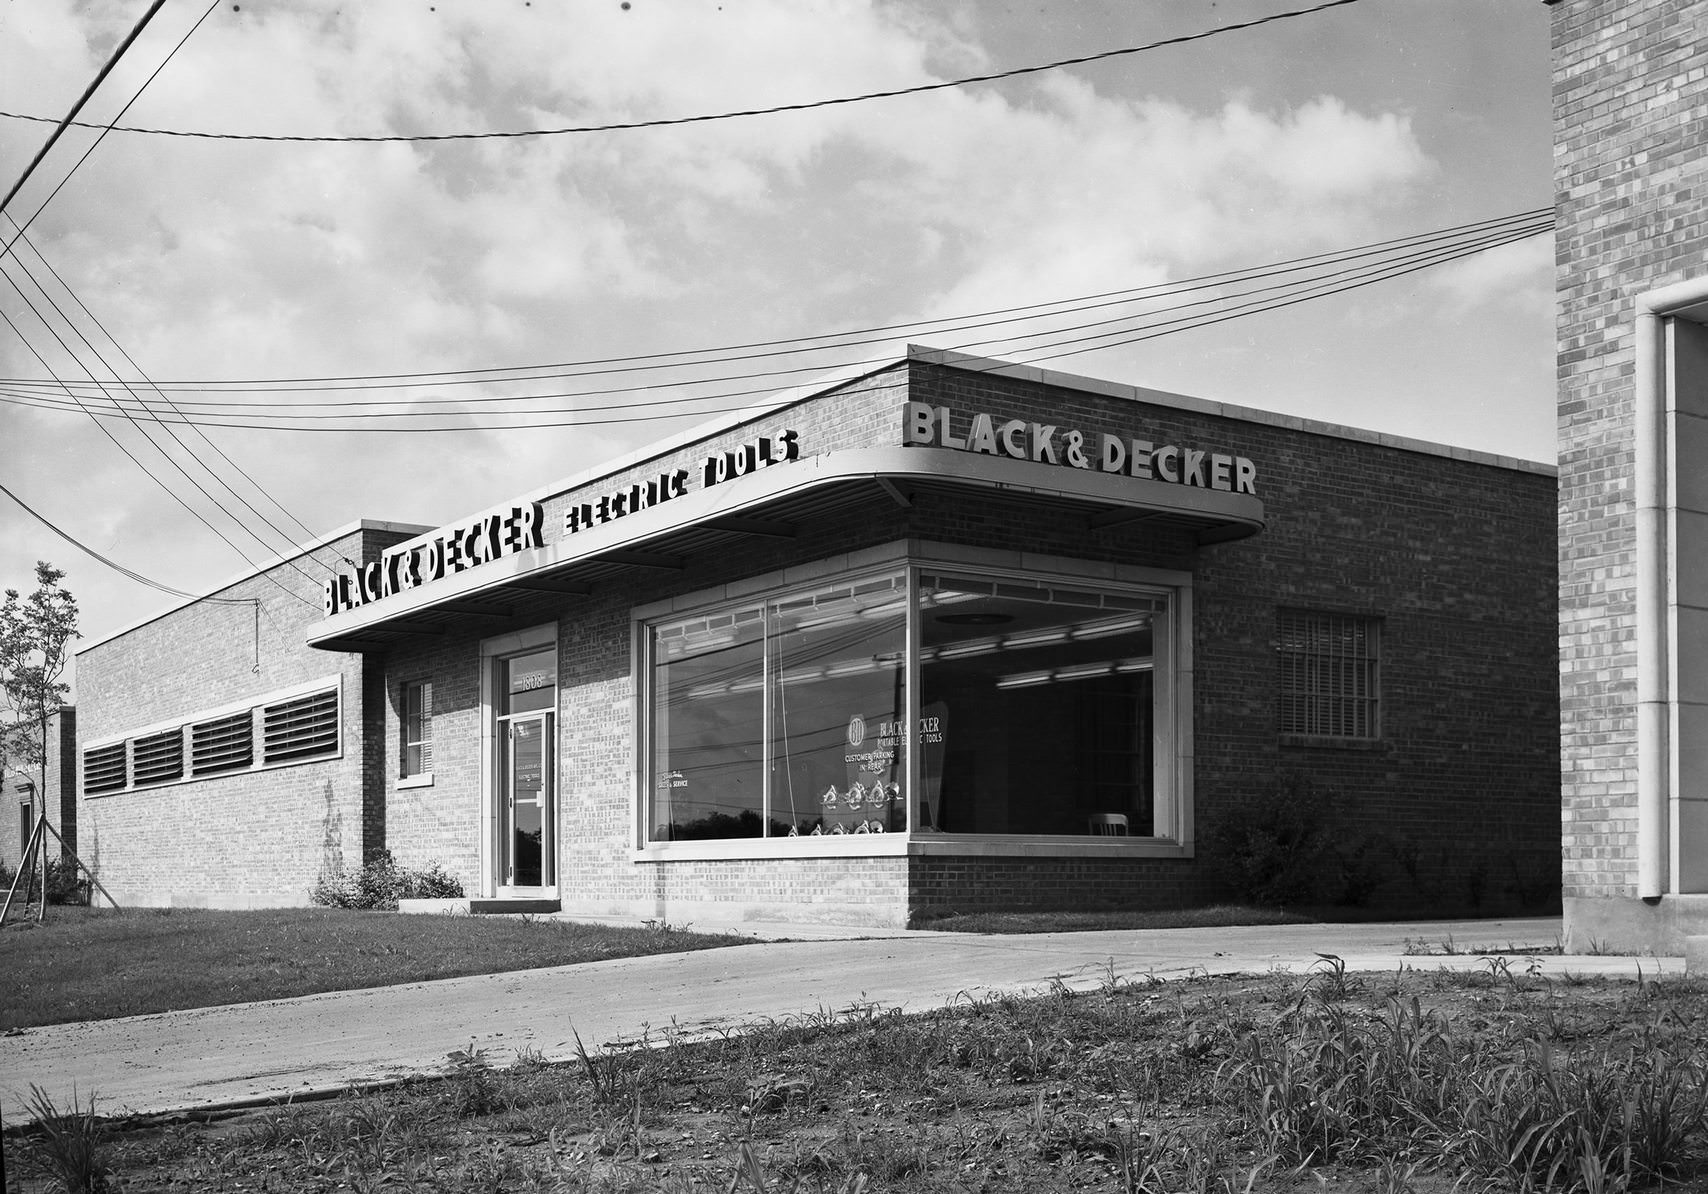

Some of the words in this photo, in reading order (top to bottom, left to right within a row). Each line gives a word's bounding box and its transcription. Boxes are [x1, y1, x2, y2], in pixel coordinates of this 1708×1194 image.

[902, 401, 1058, 465] BLACK
[1064, 429, 1089, 470] &
[1100, 433, 1257, 495] DECKER
[562, 468, 687, 536] ELECTRIC
[699, 428, 798, 489] TOOLS
[323, 552, 397, 618] BLACK
[403, 550, 420, 590] &
[426, 501, 544, 582] DECKER
[522, 673, 543, 691] 1808
[880, 721, 904, 737] BLACK
[926, 733, 942, 743] TOOLS
[845, 753, 871, 762] CUSTOMER
[873, 751, 894, 760] PARKING
